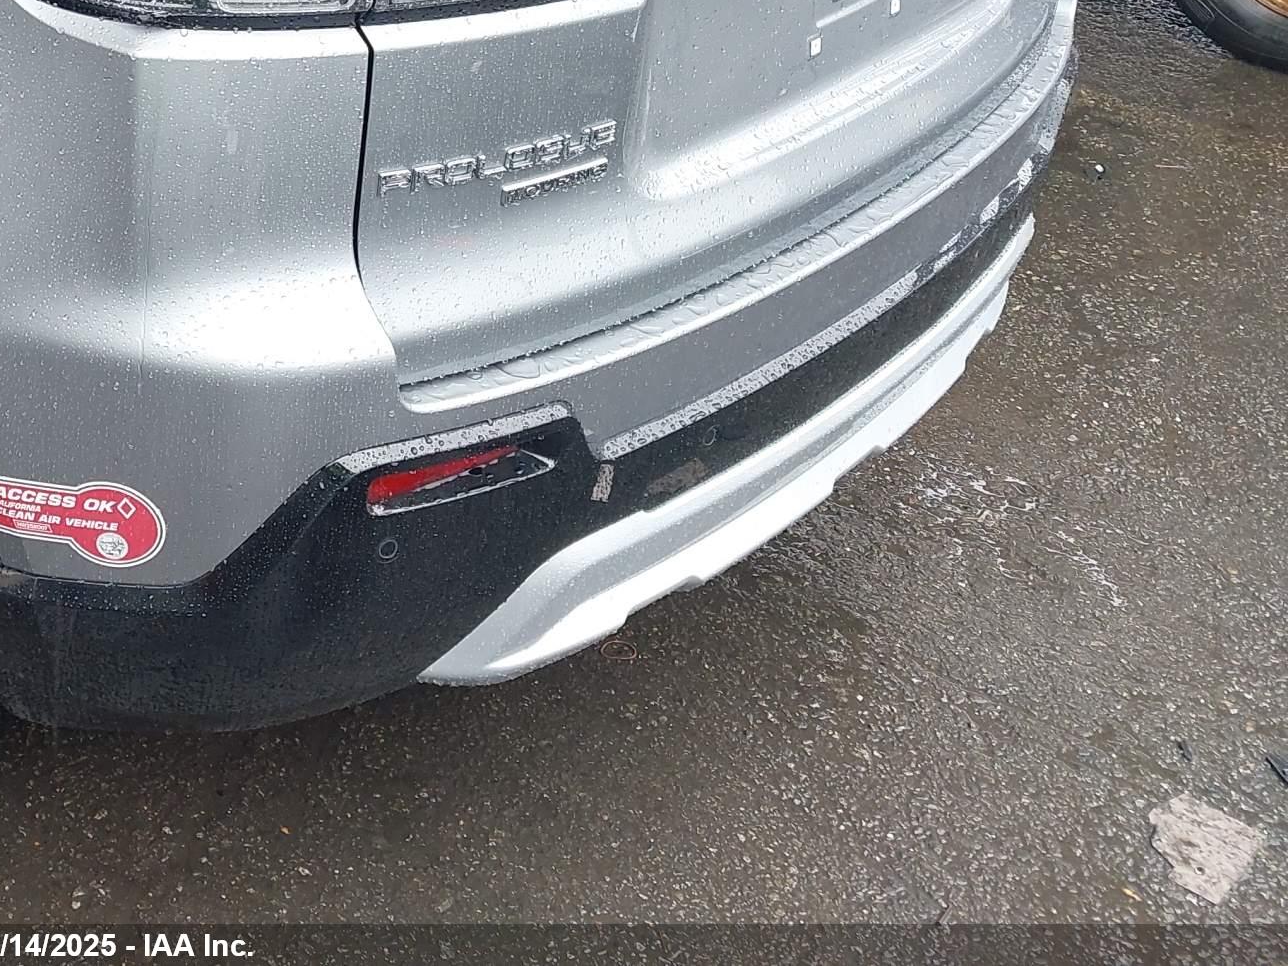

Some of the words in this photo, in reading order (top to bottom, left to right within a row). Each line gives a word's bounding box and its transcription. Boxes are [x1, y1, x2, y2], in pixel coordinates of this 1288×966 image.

[375, 118, 618, 197] PROLOGUE
[83, 497, 117, 513] OK
[38, 514, 62, 525] AIR
[65, 518, 119, 531] VEHICLE
